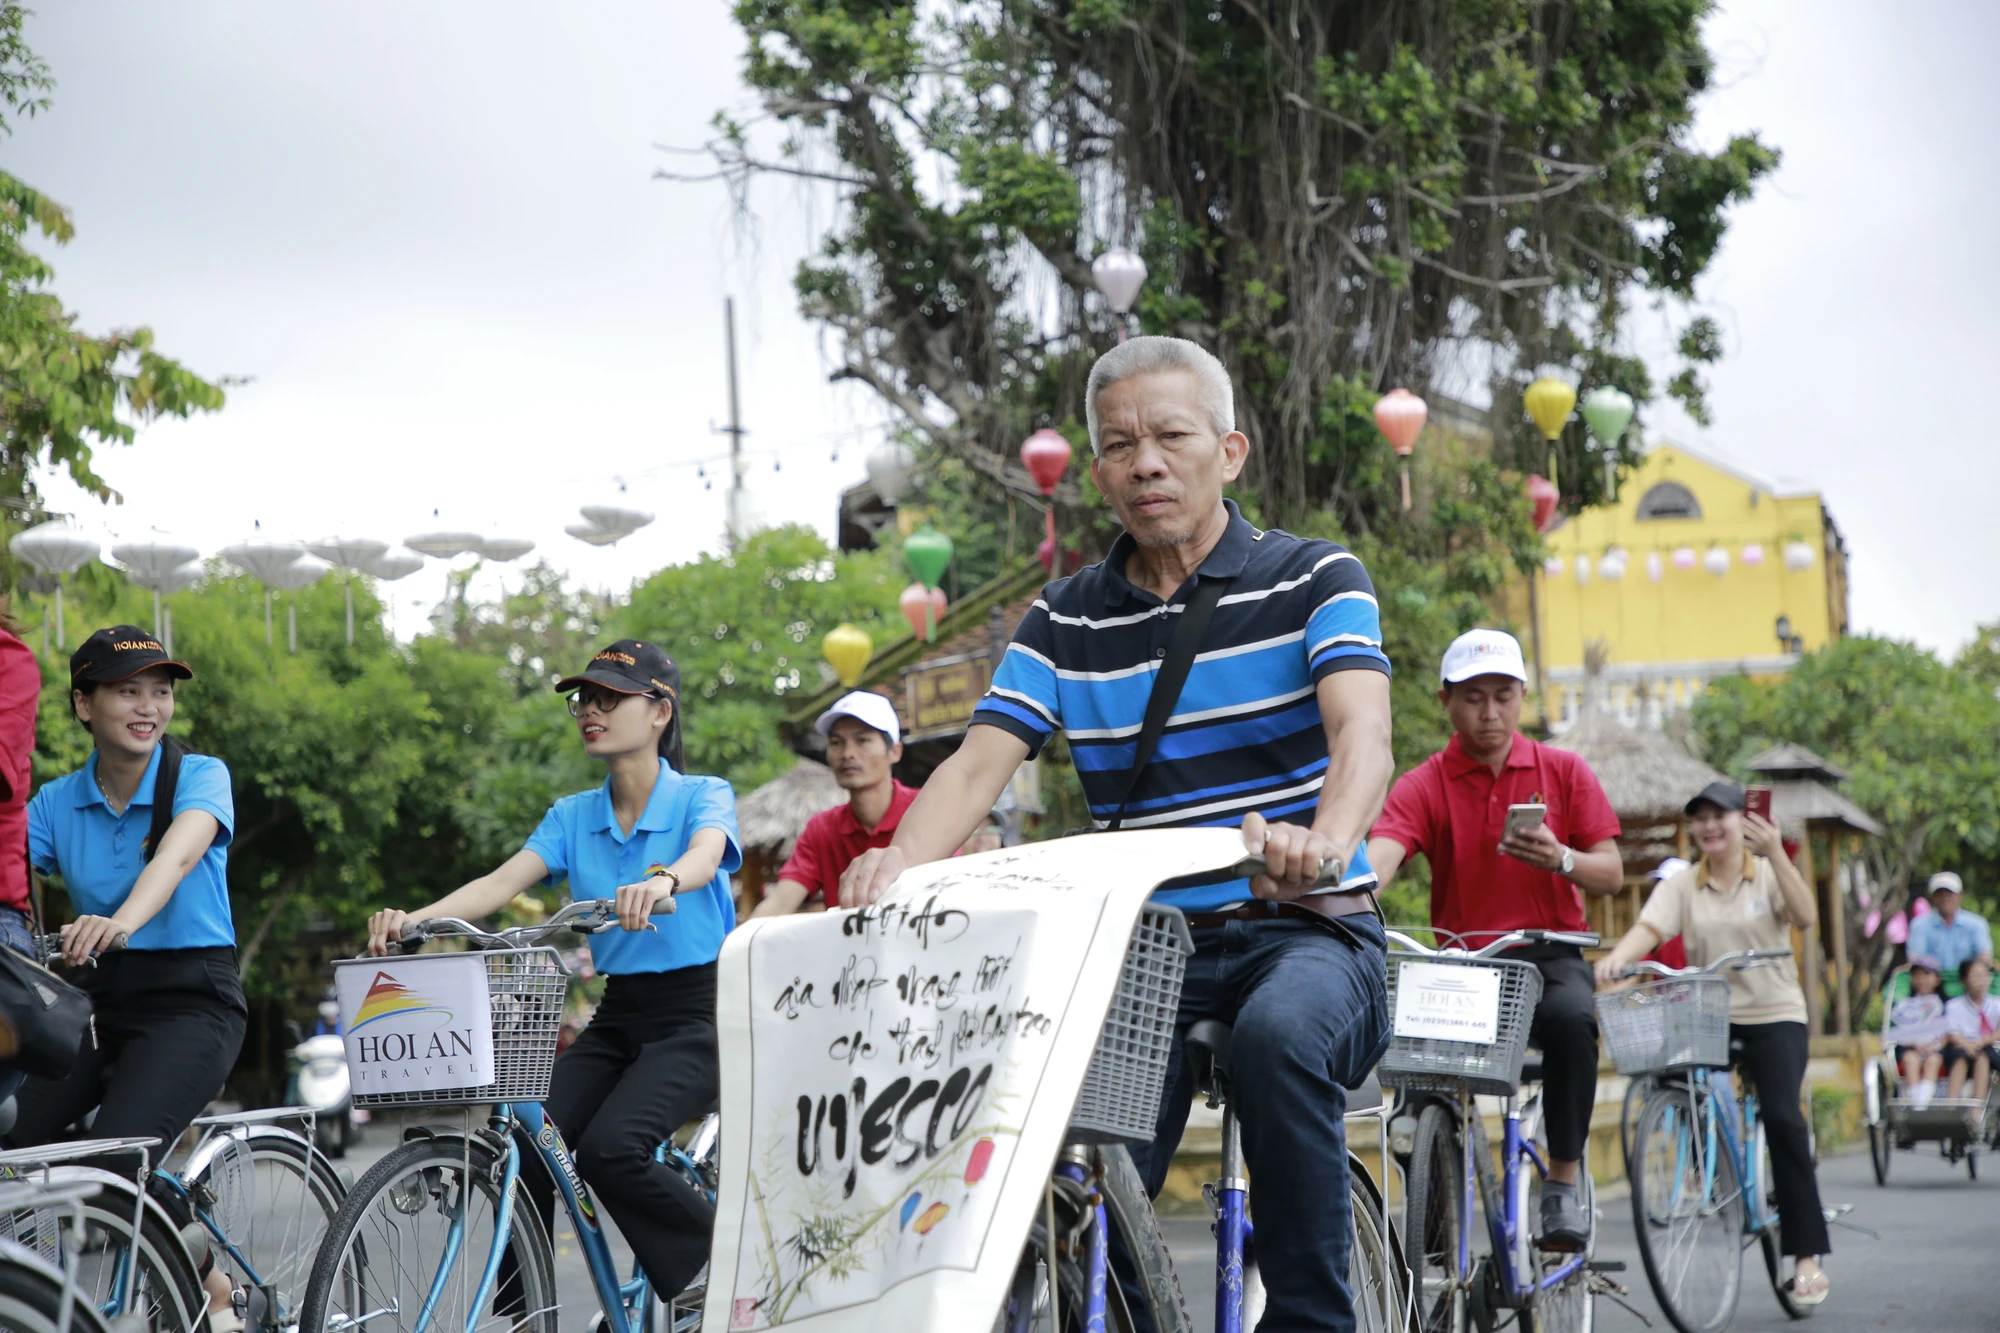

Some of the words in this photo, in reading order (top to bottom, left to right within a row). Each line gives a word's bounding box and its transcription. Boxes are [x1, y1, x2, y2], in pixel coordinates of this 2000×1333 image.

[773, 976, 824, 1020] gia
[357, 1033, 419, 1063] HOI
[424, 1028, 473, 1059] AN
[360, 1063, 478, 1080] TRAVEL
[796, 1063, 994, 1200] UNESCO
[553, 1149, 588, 1200] martin
